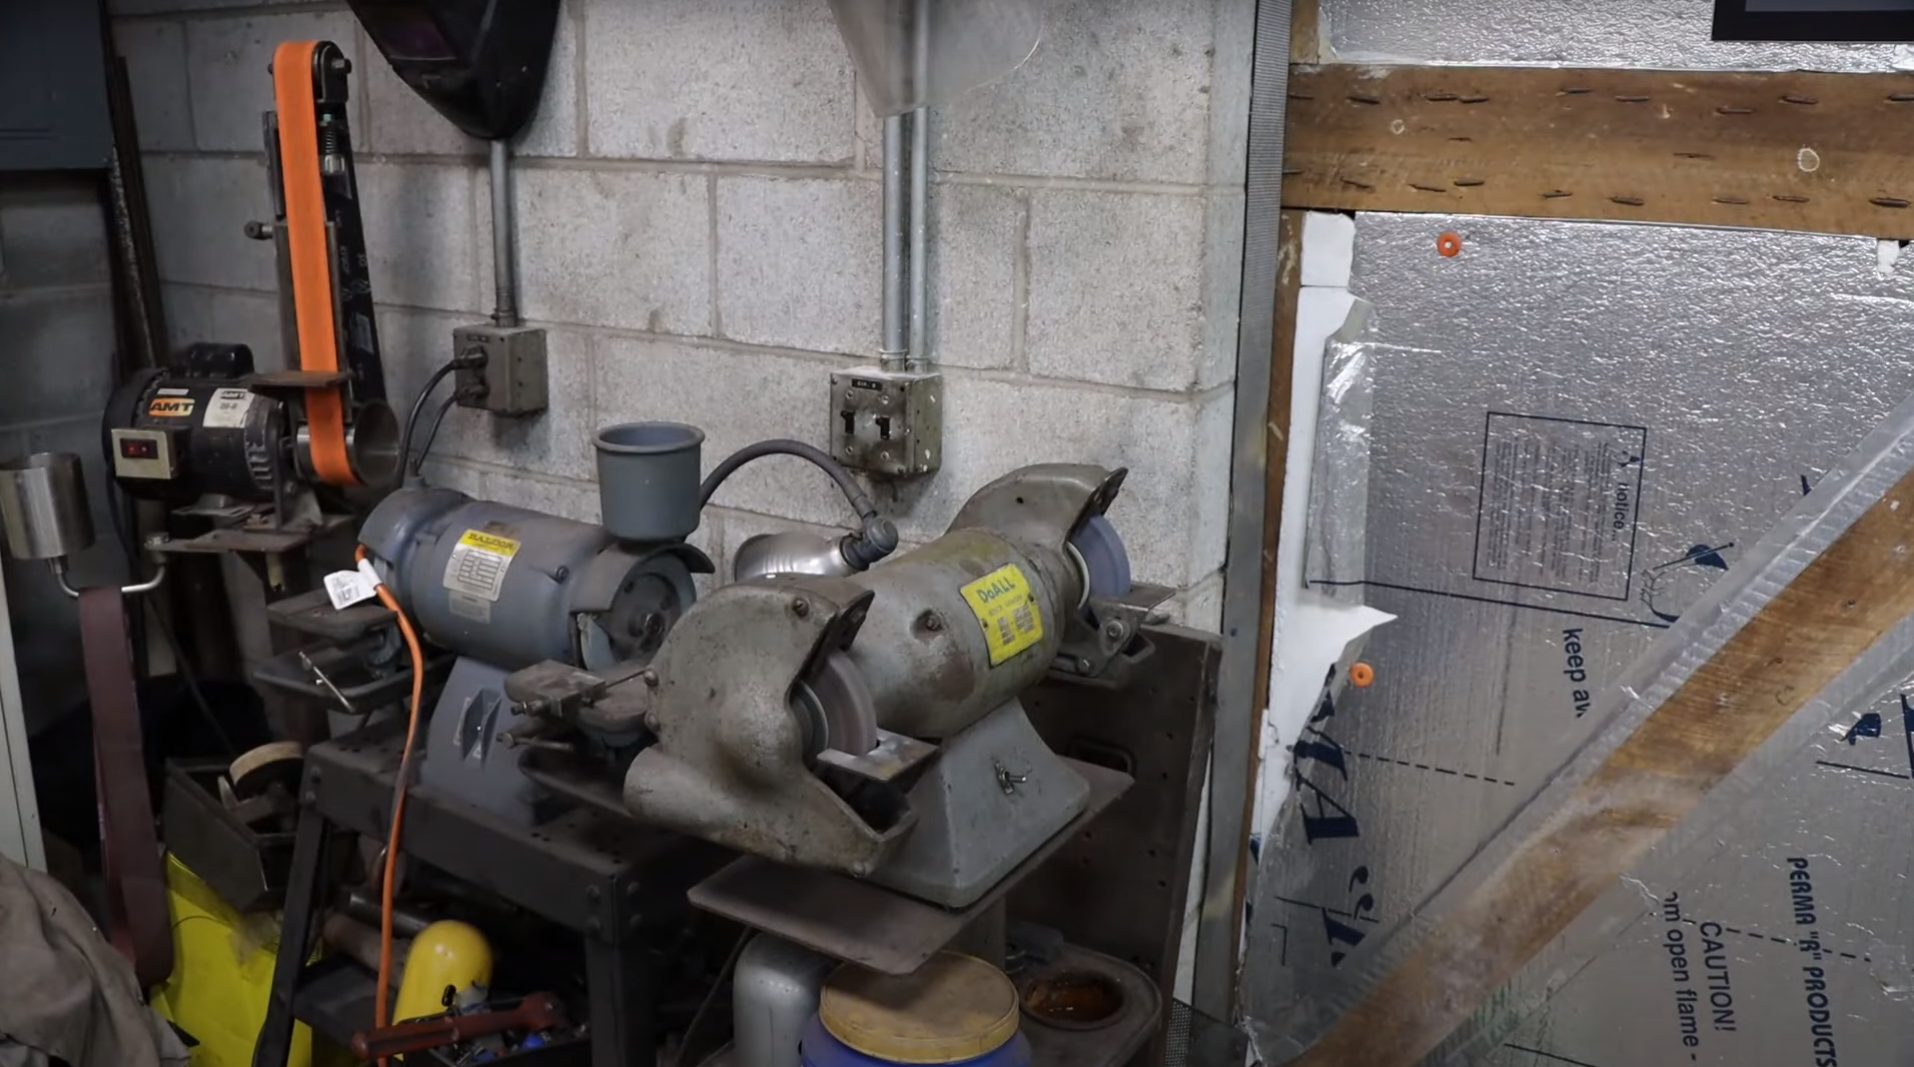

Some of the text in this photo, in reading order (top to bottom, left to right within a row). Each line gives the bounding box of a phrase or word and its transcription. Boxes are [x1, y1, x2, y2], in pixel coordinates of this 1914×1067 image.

[150, 402, 195, 412] AMT
[976, 576, 1016, 603] DoALL
[1562, 628, 1587, 683] keep
[1787, 857, 1817, 925] PERMA
[1663, 929, 1691, 982] open
[1699, 921, 1737, 1032] CAUTION!
[1675, 988, 1700, 1047] flame
